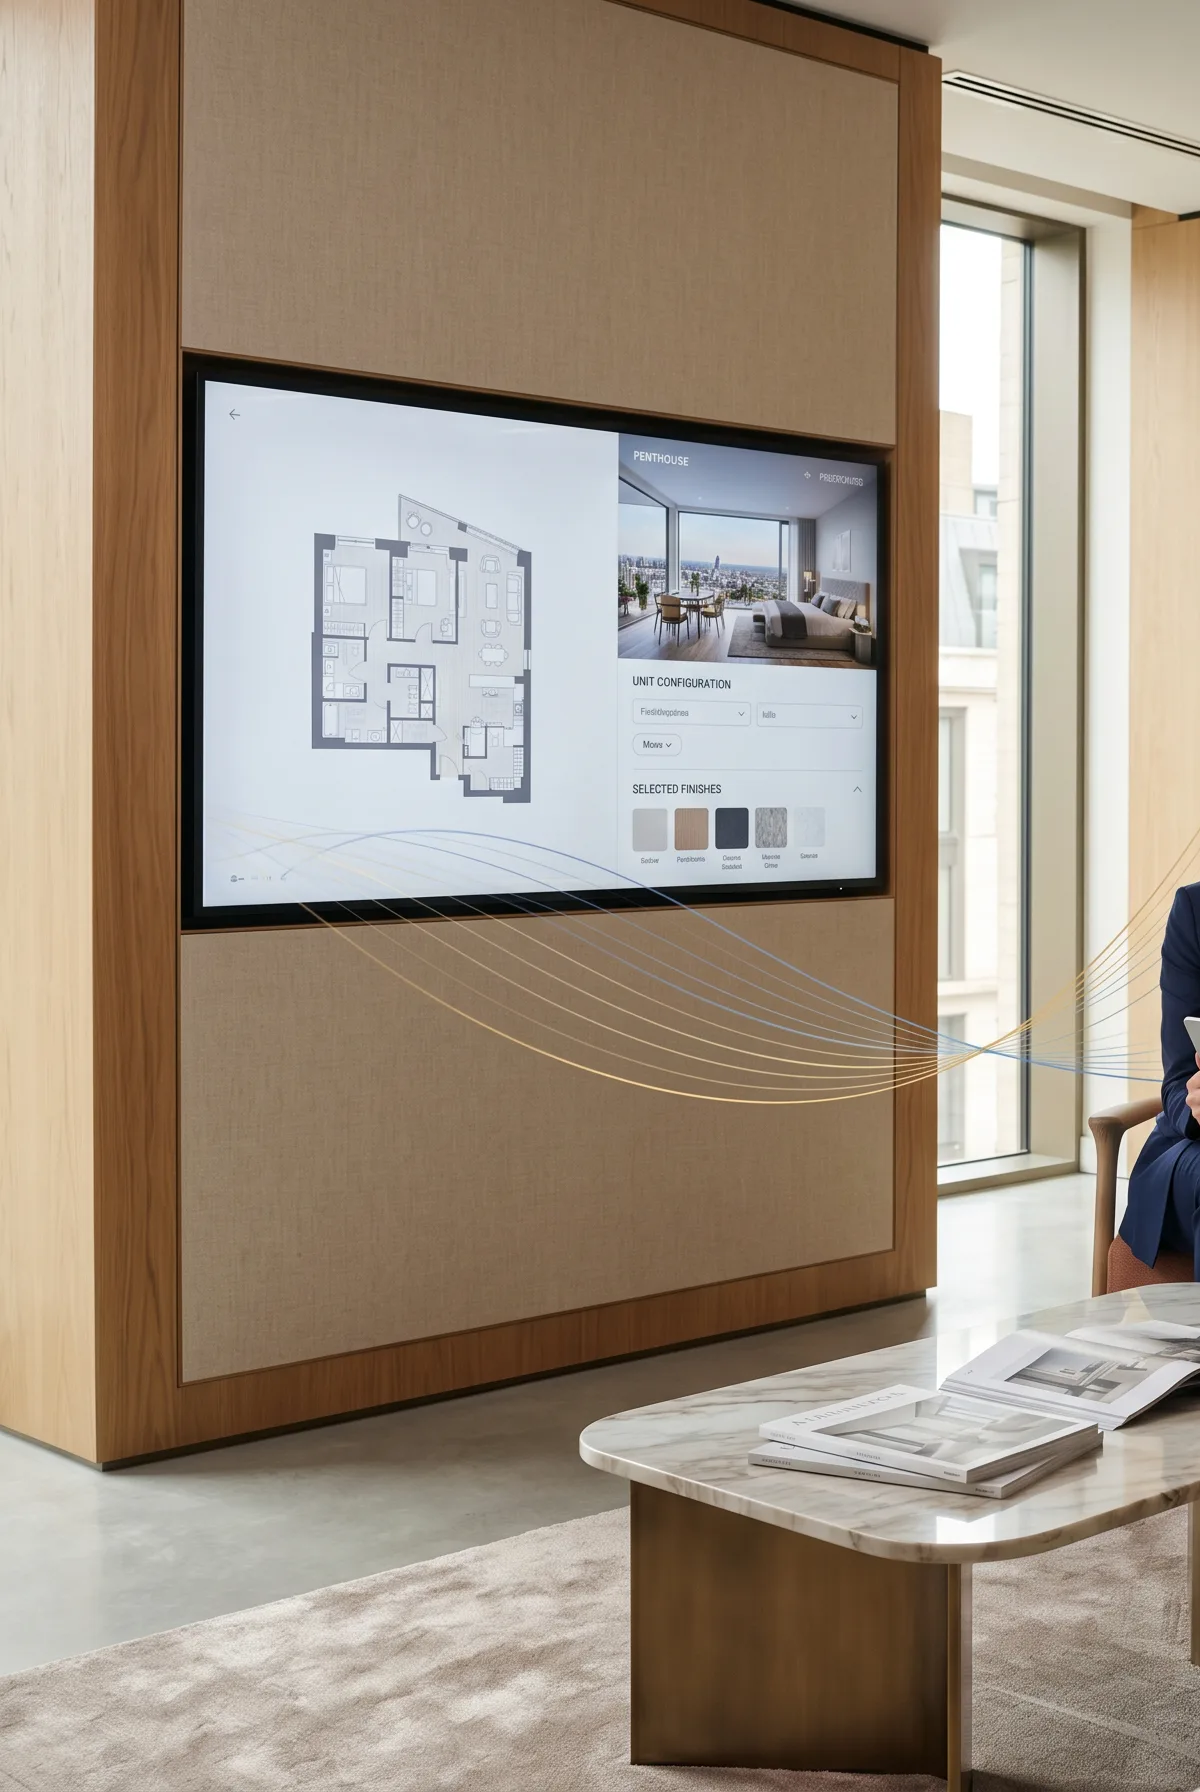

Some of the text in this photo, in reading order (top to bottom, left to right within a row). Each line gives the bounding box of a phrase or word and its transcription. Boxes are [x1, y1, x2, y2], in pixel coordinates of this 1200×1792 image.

[633, 450, 690, 467] PENTHOUSE
[632, 675, 732, 690] UNIT CONFIGURATION
[632, 783, 722, 795] SELECTED FINISHES
